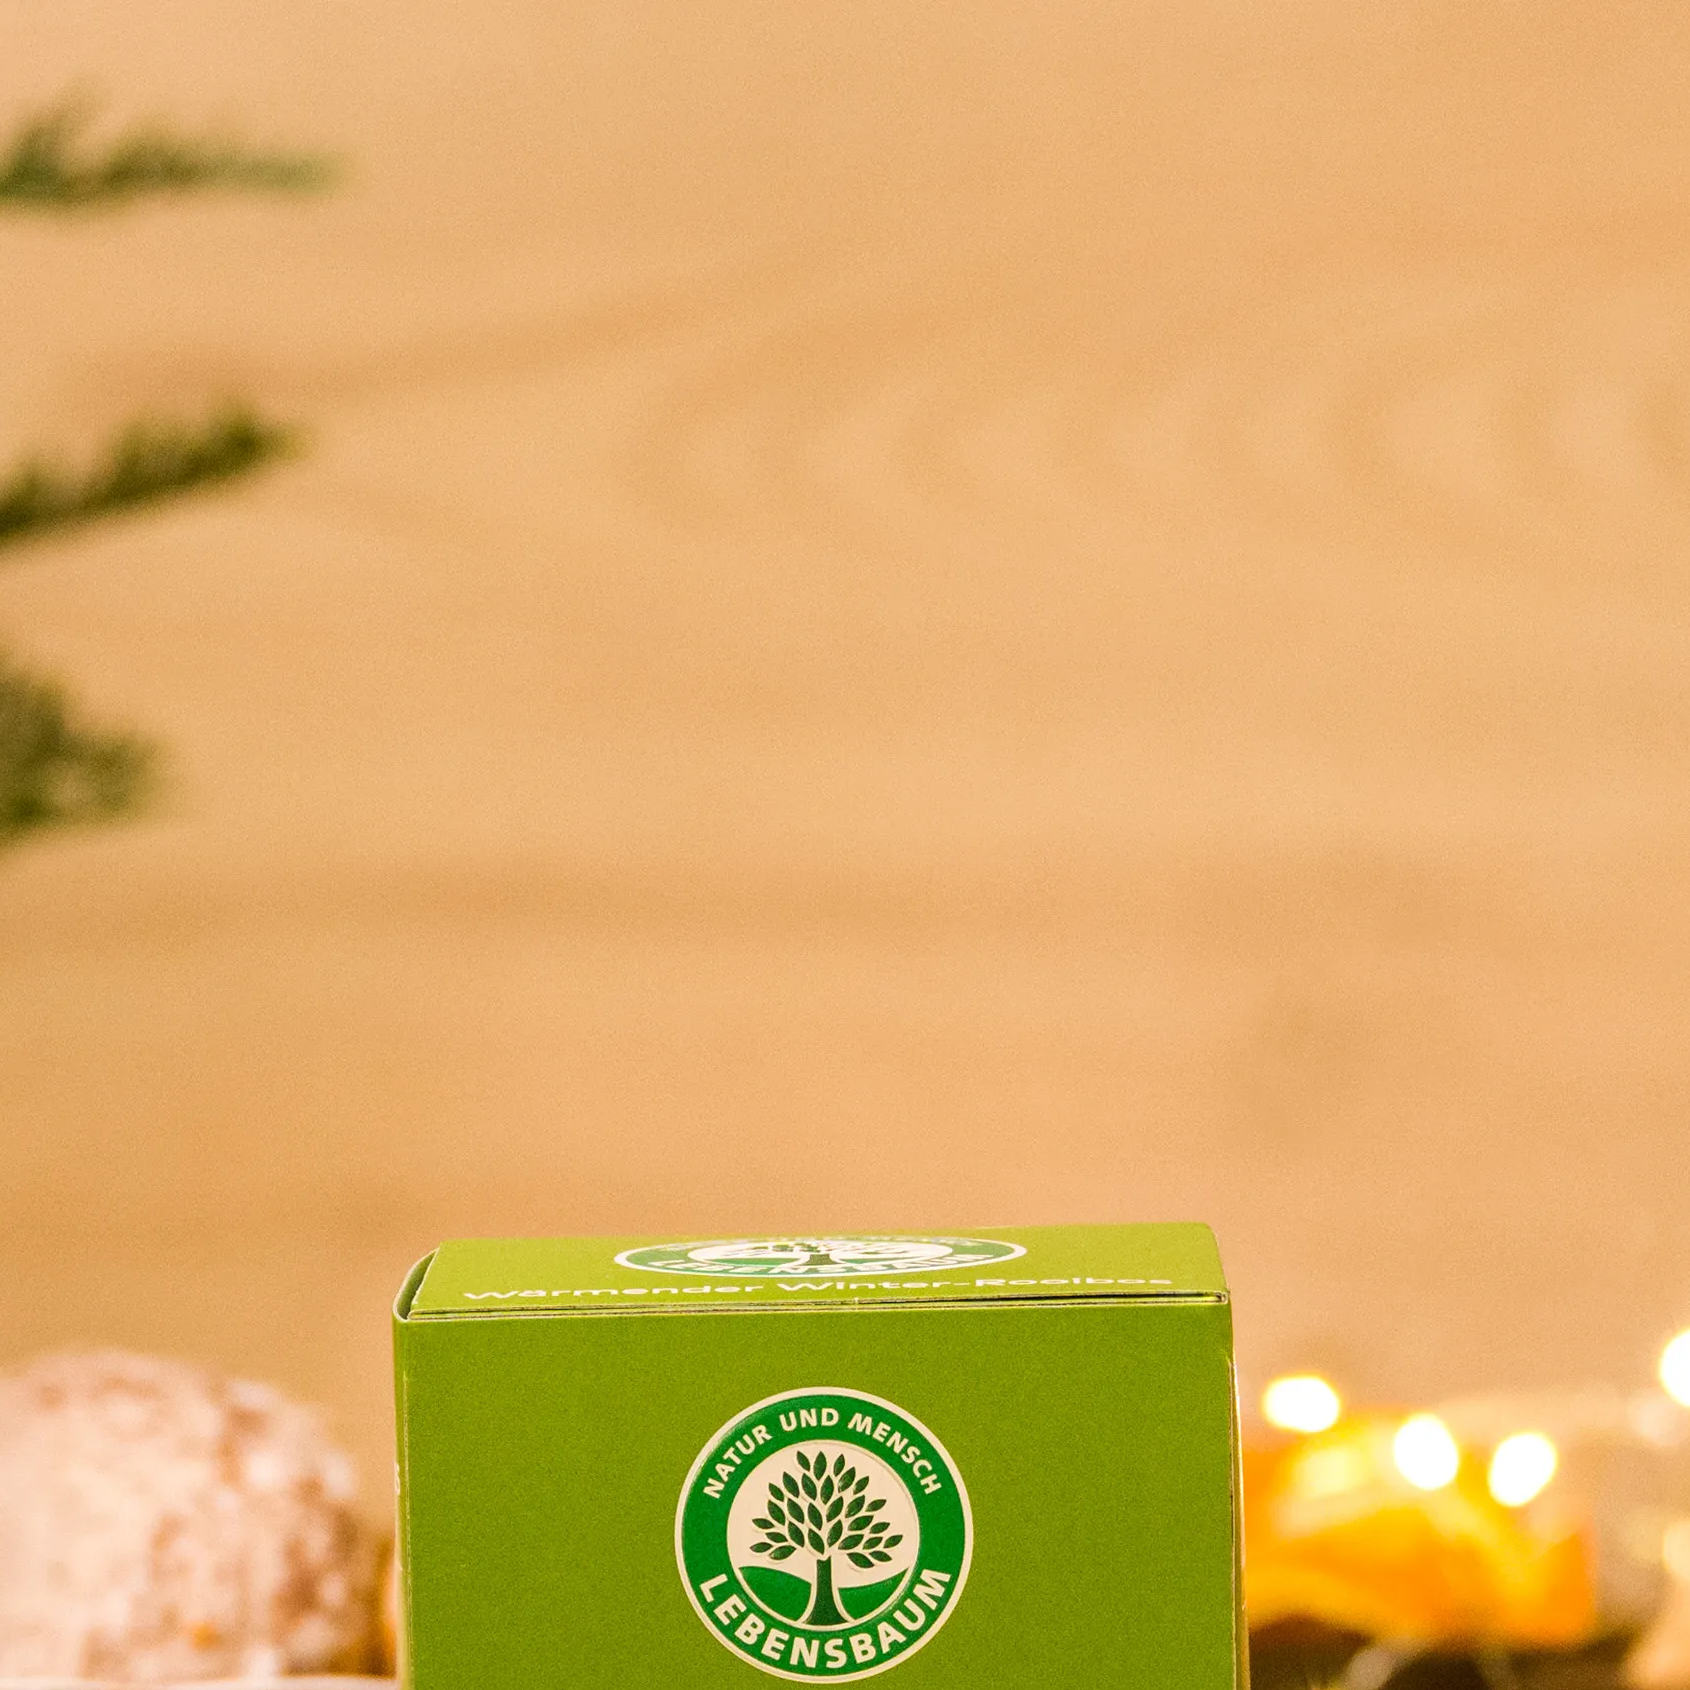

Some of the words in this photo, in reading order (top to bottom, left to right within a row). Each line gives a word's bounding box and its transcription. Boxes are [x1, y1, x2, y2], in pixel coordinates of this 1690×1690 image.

[703, 1424, 773, 1499] NATUR
[779, 1407, 840, 1432] UND
[847, 1412, 942, 1495] MENSCH
[699, 1569, 952, 1669] LEBENSBAUM
